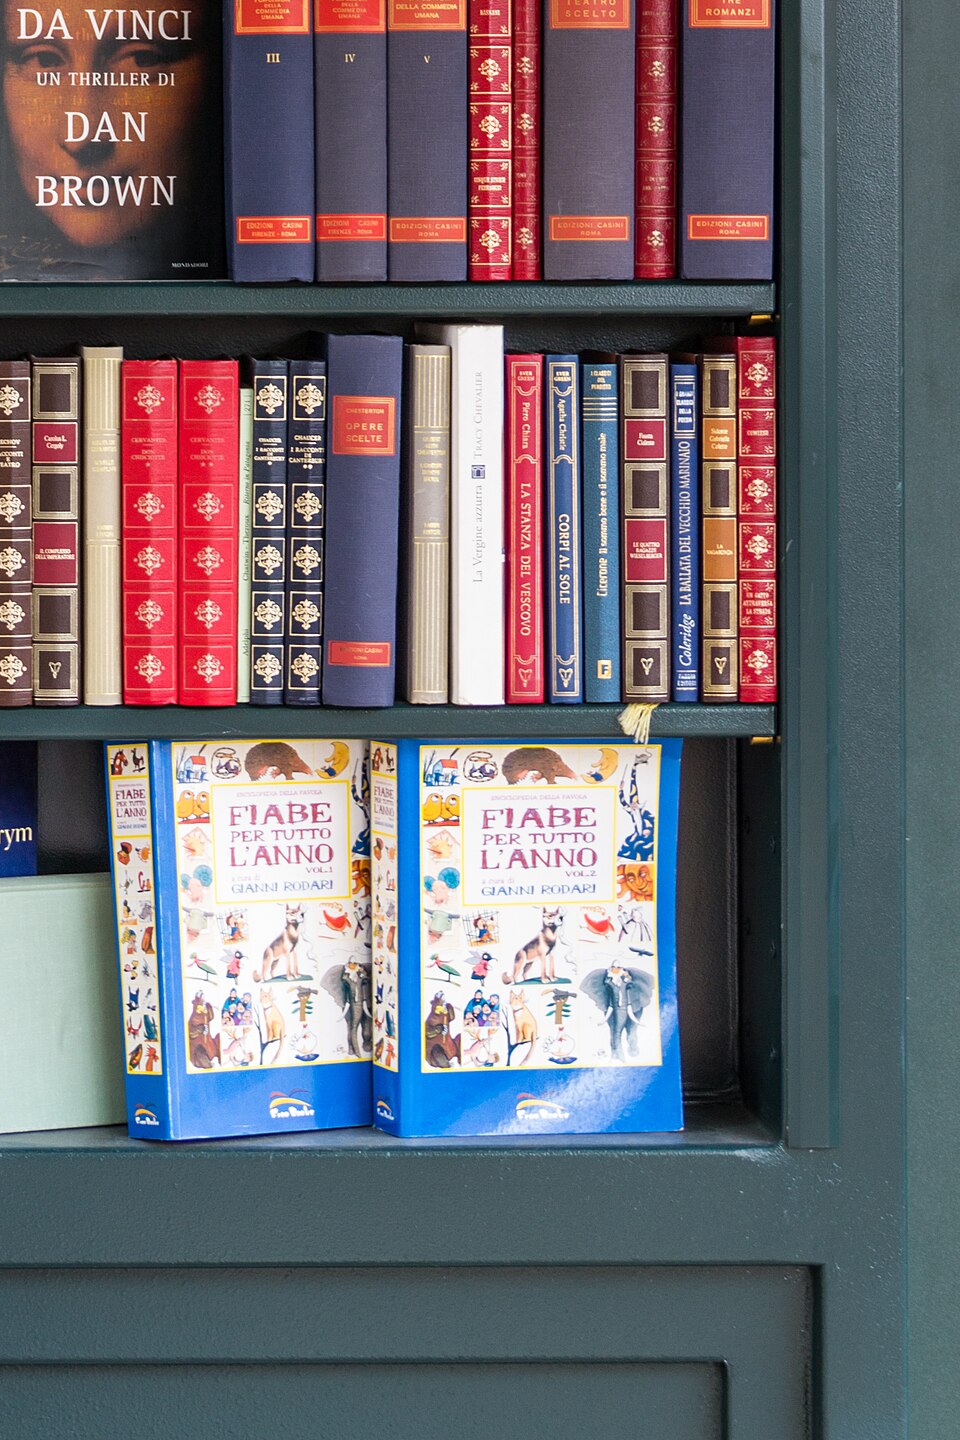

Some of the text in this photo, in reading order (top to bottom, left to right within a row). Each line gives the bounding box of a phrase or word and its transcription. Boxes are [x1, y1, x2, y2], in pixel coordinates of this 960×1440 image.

[565, 10, 617, 18] SCELTO
[705, 8, 755, 16] ROMANZI
[17, 8, 192, 40] DA VINCI
[267, 54, 279, 62] III
[346, 54, 355, 62] IV
[36, 72, 174, 85] UN THRILLER DI
[65, 112, 148, 142] DAN
[35, 176, 175, 207] BROWN
[344, 421, 384, 432] OPERE
[344, 433, 383, 444] SCELTE
[521, 484, 531, 635] LA STANZA DEL VESCOVO
[559, 514, 570, 603] CORPI AL SOLE
[679, 614, 695, 666] Coleridge
[230, 802, 332, 826] FIABE
[482, 806, 596, 829] FIABE
[232, 828, 331, 842] PER TUTTO
[483, 832, 595, 845] PER TUTTO
[230, 844, 334, 869] L'ANNO
[481, 848, 597, 869] L'ANNO
[232, 880, 333, 893] GIANNI RODARI
[482, 884, 595, 895] GIANNI RODARI
